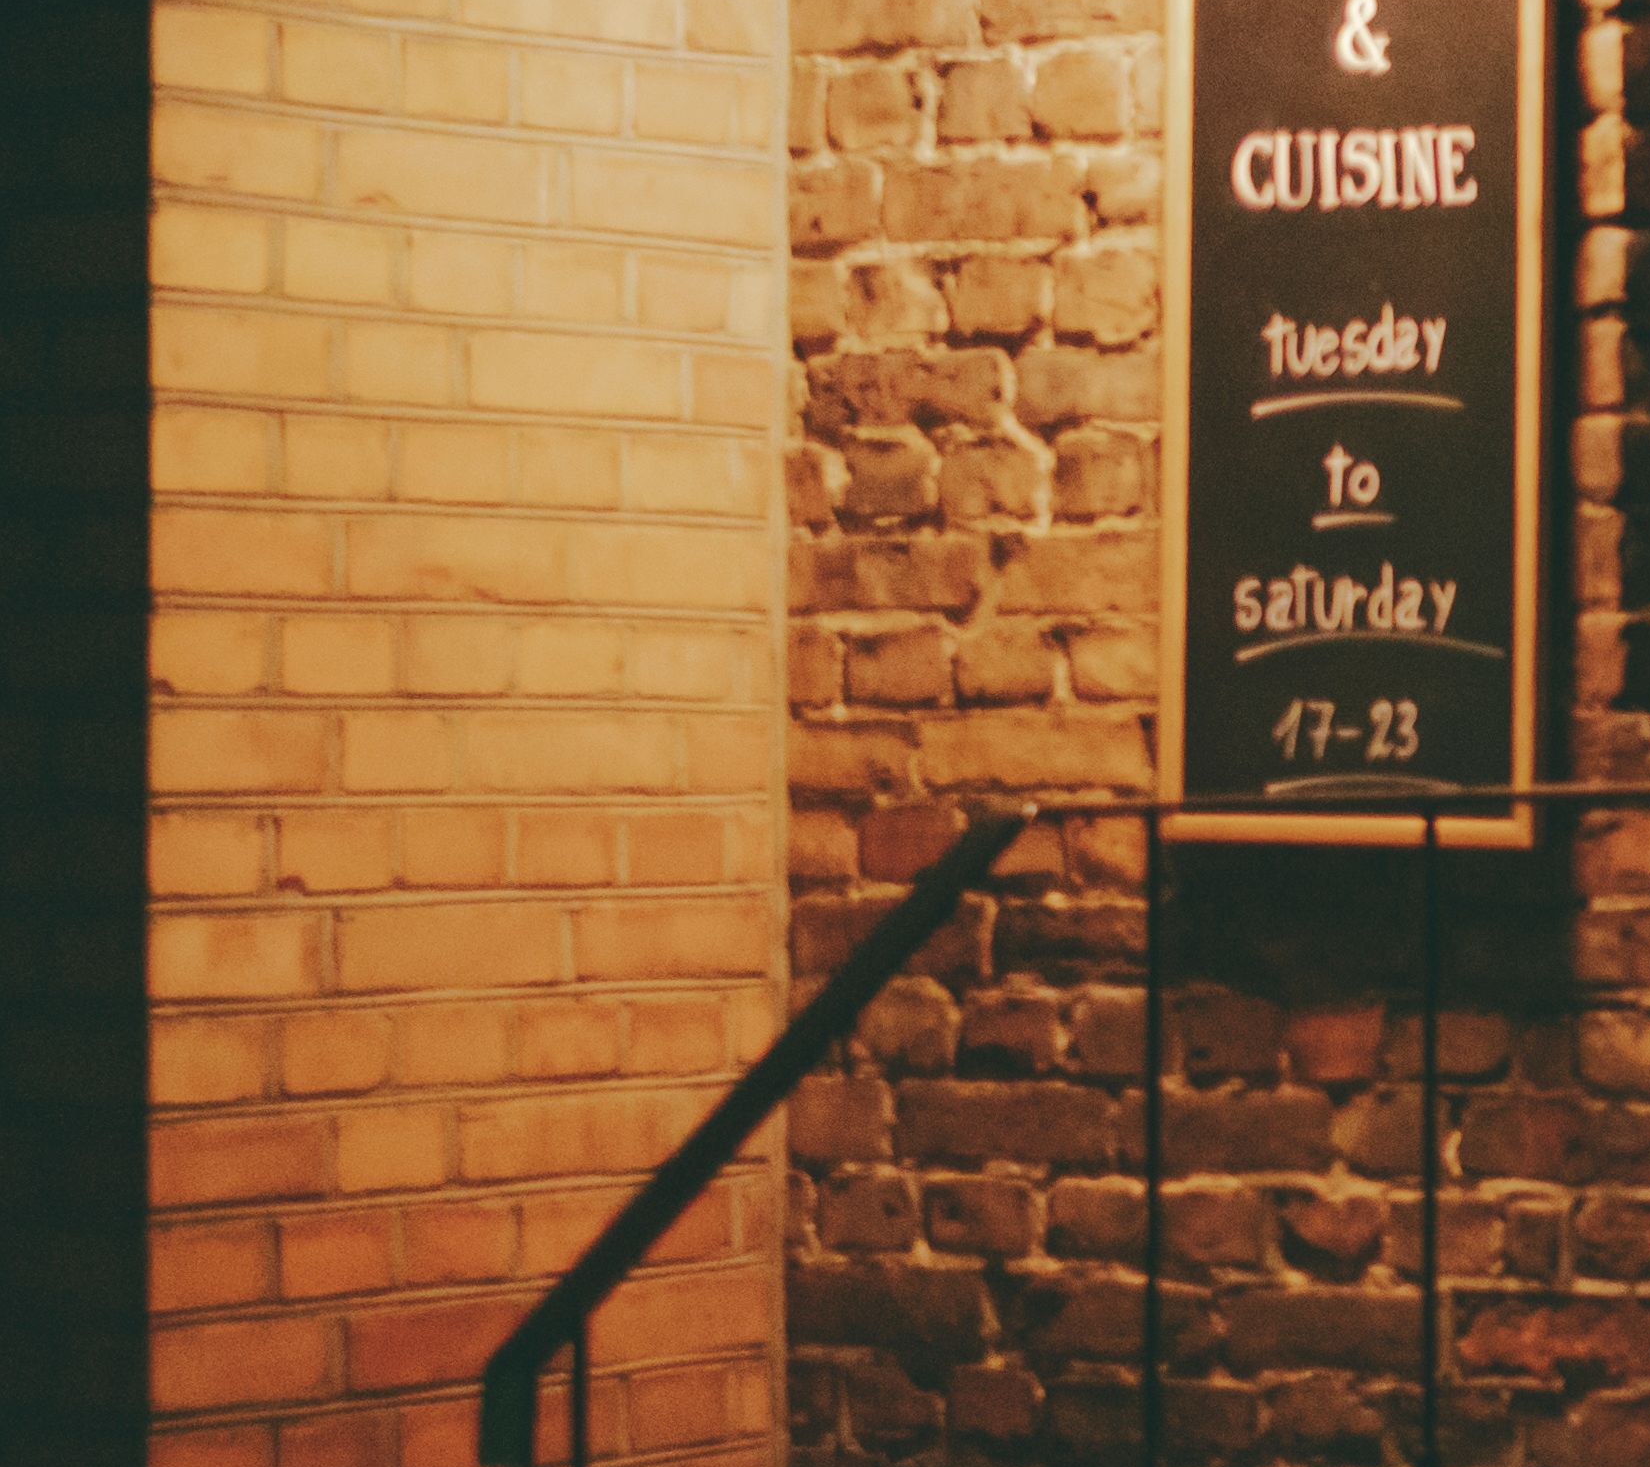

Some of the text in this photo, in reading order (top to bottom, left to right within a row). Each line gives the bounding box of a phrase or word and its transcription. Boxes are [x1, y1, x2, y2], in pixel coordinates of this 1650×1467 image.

[1231, 126, 1477, 209] CUISINE
[1323, 443, 1380, 507] to
[1233, 561, 1457, 631] saturday
[1273, 697, 1419, 760] 17-23
